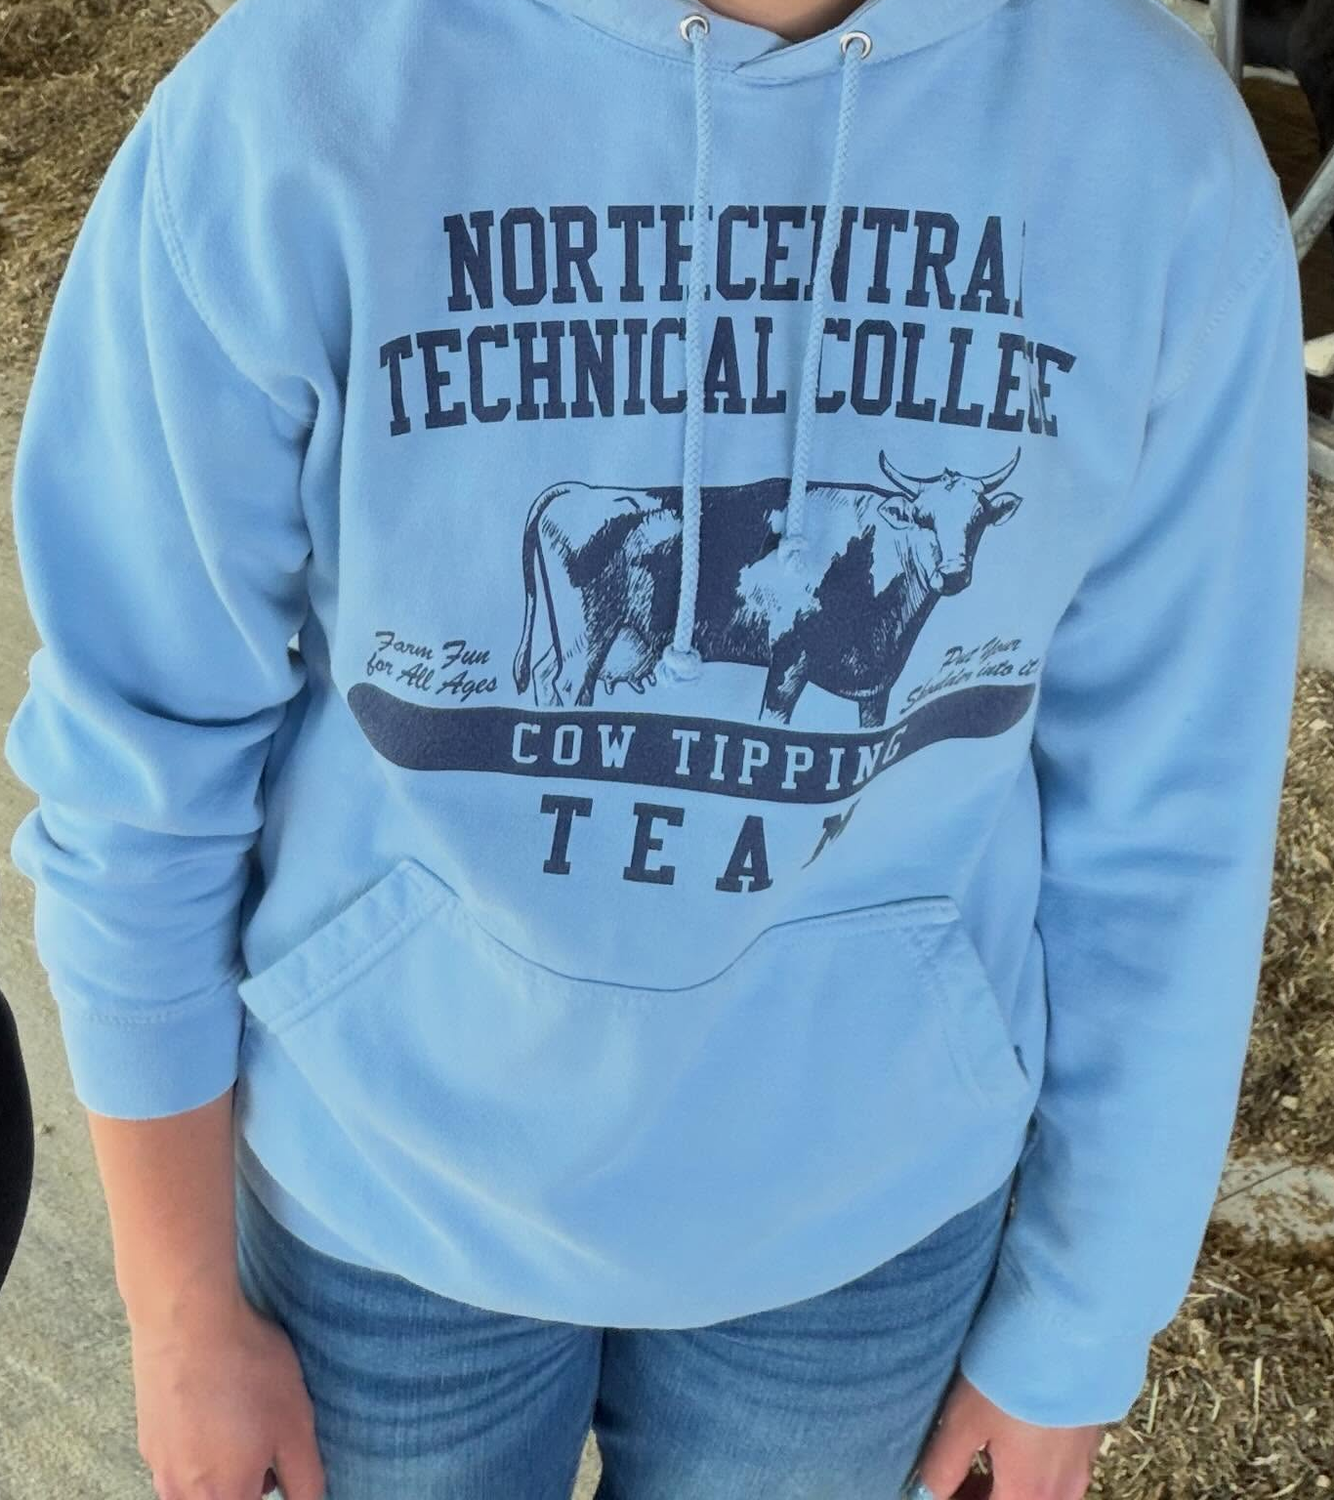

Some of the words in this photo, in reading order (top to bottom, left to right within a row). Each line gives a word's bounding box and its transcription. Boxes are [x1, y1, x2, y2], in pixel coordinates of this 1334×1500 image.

[443, 204, 1024, 318] NORTHCENTRA
[379, 316, 787, 437] TECHNICAL
[366, 651, 394, 677] for
[395, 662, 435, 692] All
[434, 669, 499, 703] Ages
[374, 630, 433, 660] Farm
[441, 639, 491, 670] Fun
[975, 660, 1015, 679] into
[511, 722, 635, 770] COW
[672, 724, 909, 792] TIPPING
